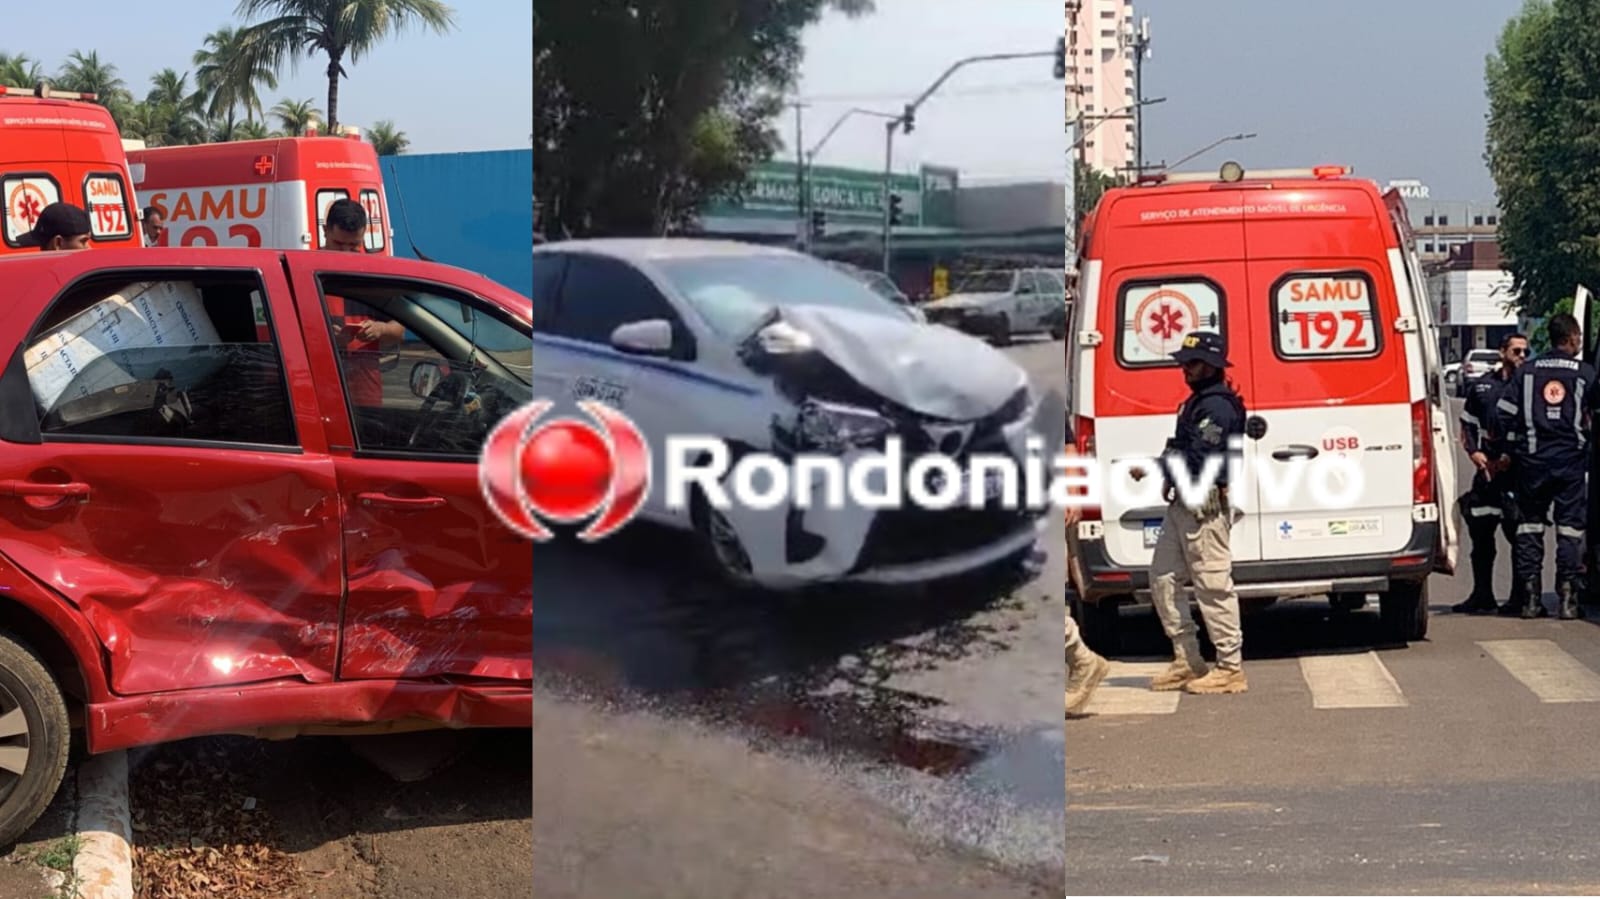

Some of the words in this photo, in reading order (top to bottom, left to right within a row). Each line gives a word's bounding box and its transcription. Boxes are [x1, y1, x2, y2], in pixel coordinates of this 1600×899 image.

[90, 181, 119, 196] SAMU
[149, 187, 267, 222] SAMU
[93, 203, 126, 233] 192
[1290, 281, 1363, 302] SAMU
[1293, 310, 1367, 349] 192
[1323, 437, 1359, 451] USB
